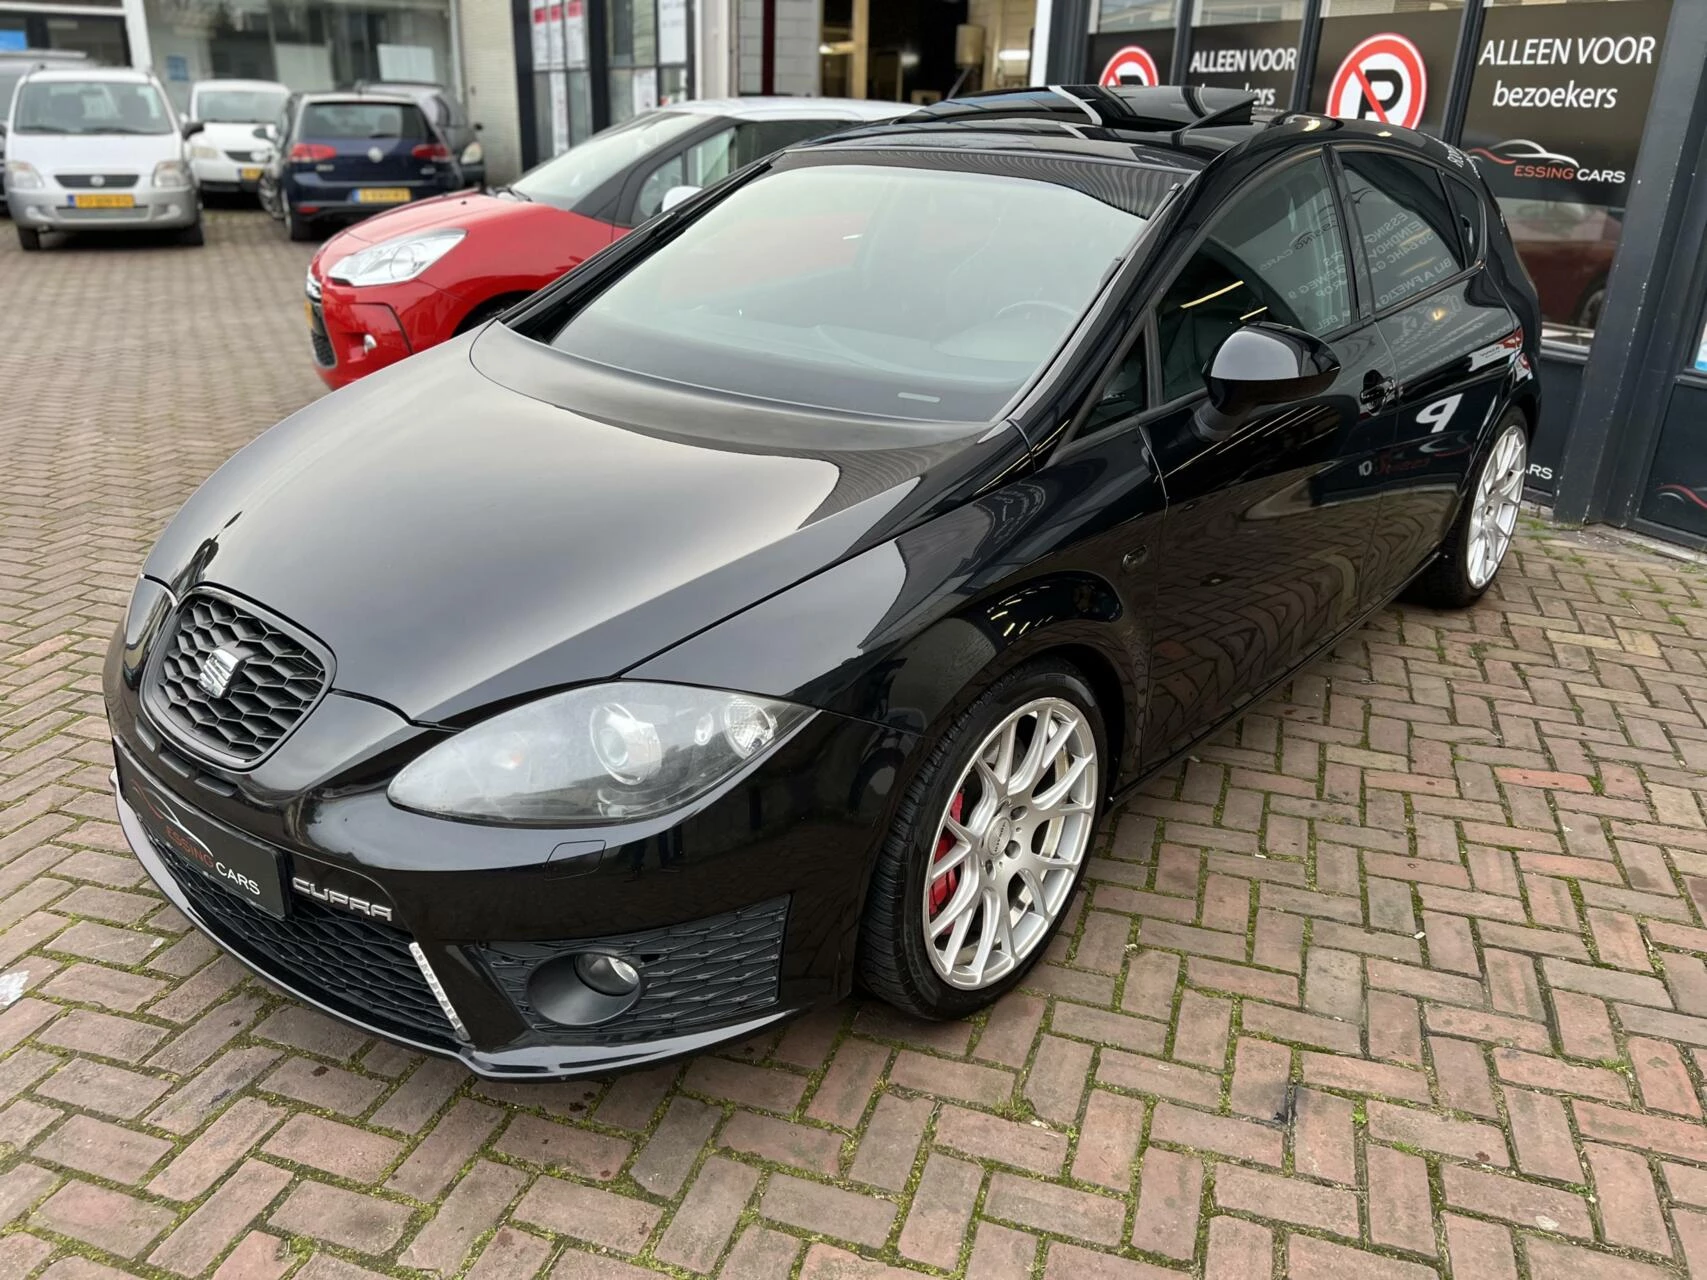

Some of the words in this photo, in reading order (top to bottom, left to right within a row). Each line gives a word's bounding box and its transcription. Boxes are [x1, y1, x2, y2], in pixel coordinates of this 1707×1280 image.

[1189, 49, 1248, 73] ALLEEN
[1249, 47, 1297, 71] VOOR
[1478, 38, 1572, 66] ALLEEN
[1577, 36, 1656, 65] VOOR
[1492, 79, 1618, 109] bezoekers
[1513, 165, 1575, 180] ESSING
[1576, 168, 1626, 184] CARS
[1525, 463, 1553, 480] RS
[165, 825, 215, 868] ESSING
[215, 862, 261, 895] CARS
[292, 876, 393, 922] CUPRA
